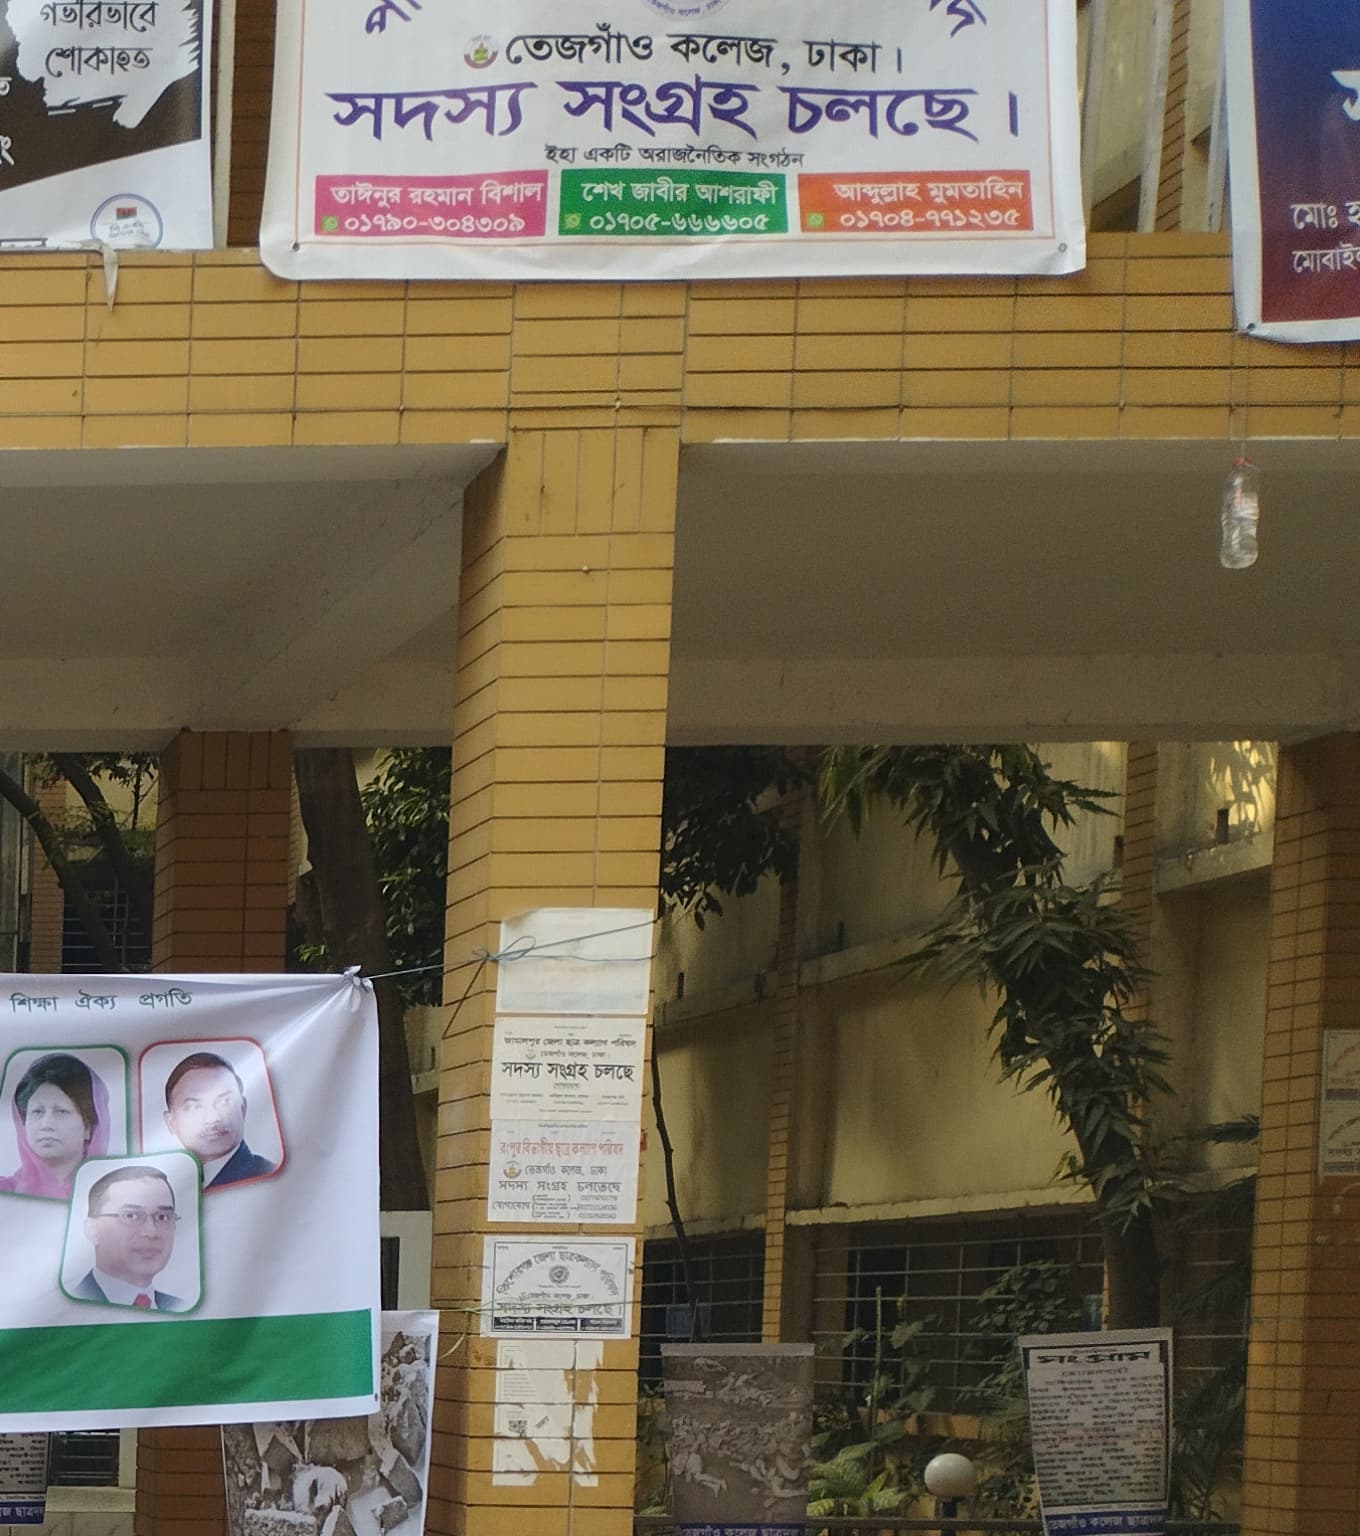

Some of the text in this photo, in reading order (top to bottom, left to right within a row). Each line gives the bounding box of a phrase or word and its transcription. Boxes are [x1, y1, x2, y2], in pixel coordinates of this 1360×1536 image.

[506, 24, 653, 63] তেজগাঁও
[803, 40, 882, 73] ঢাকা
[45, 46, 153, 79] শোকাহত
[325, 81, 538, 142] সদস্য
[556, 73, 760, 138] সংগ্রহ
[777, 87, 978, 142] চলছে
[545, 142, 803, 167] ইহা একটি অরাজনৈতিক সংগঠন
[409, 185, 472, 207] রহমান
[480, 178, 543, 205] বিশাল
[582, 180, 623, 204] শেখ
[630, 177, 688, 204] জাবীর
[927, 179, 1024, 204] মুমতাহিন
[344, 214, 526, 233] ০১৭৯০-৩০৪৩০৯
[590, 213, 770, 232] ০১৭০৫-৬৬৬৬০৫
[840, 213, 1019, 228] ০১৭০৪-৭৭১২৩৫
[1290, 202, 1337, 229] মোঃ
[10, 988, 192, 1012] শিক্ষা ঐক্য প্রগতি
[502, 1062, 635, 1081] সদস্য সংগ্রহ চলছে
